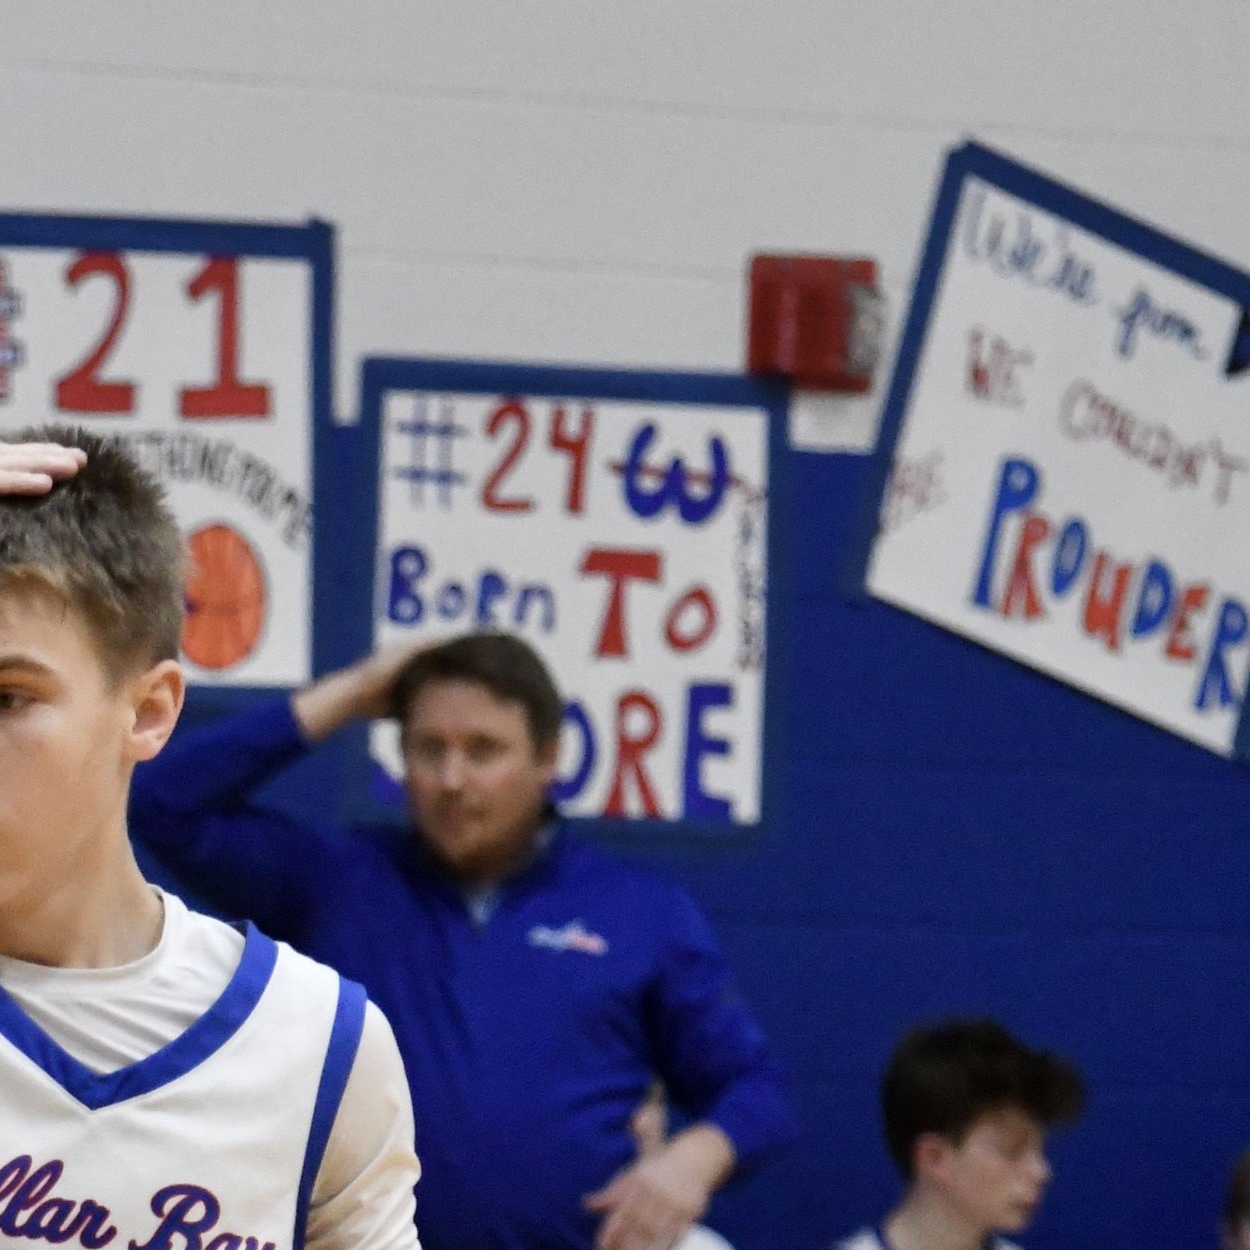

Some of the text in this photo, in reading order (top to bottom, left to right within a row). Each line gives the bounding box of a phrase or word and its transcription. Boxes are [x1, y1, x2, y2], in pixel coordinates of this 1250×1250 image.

[395, 396, 593, 515] #24
[578, 548, 716, 660] To
[971, 456, 1249, 712] PROUDER
